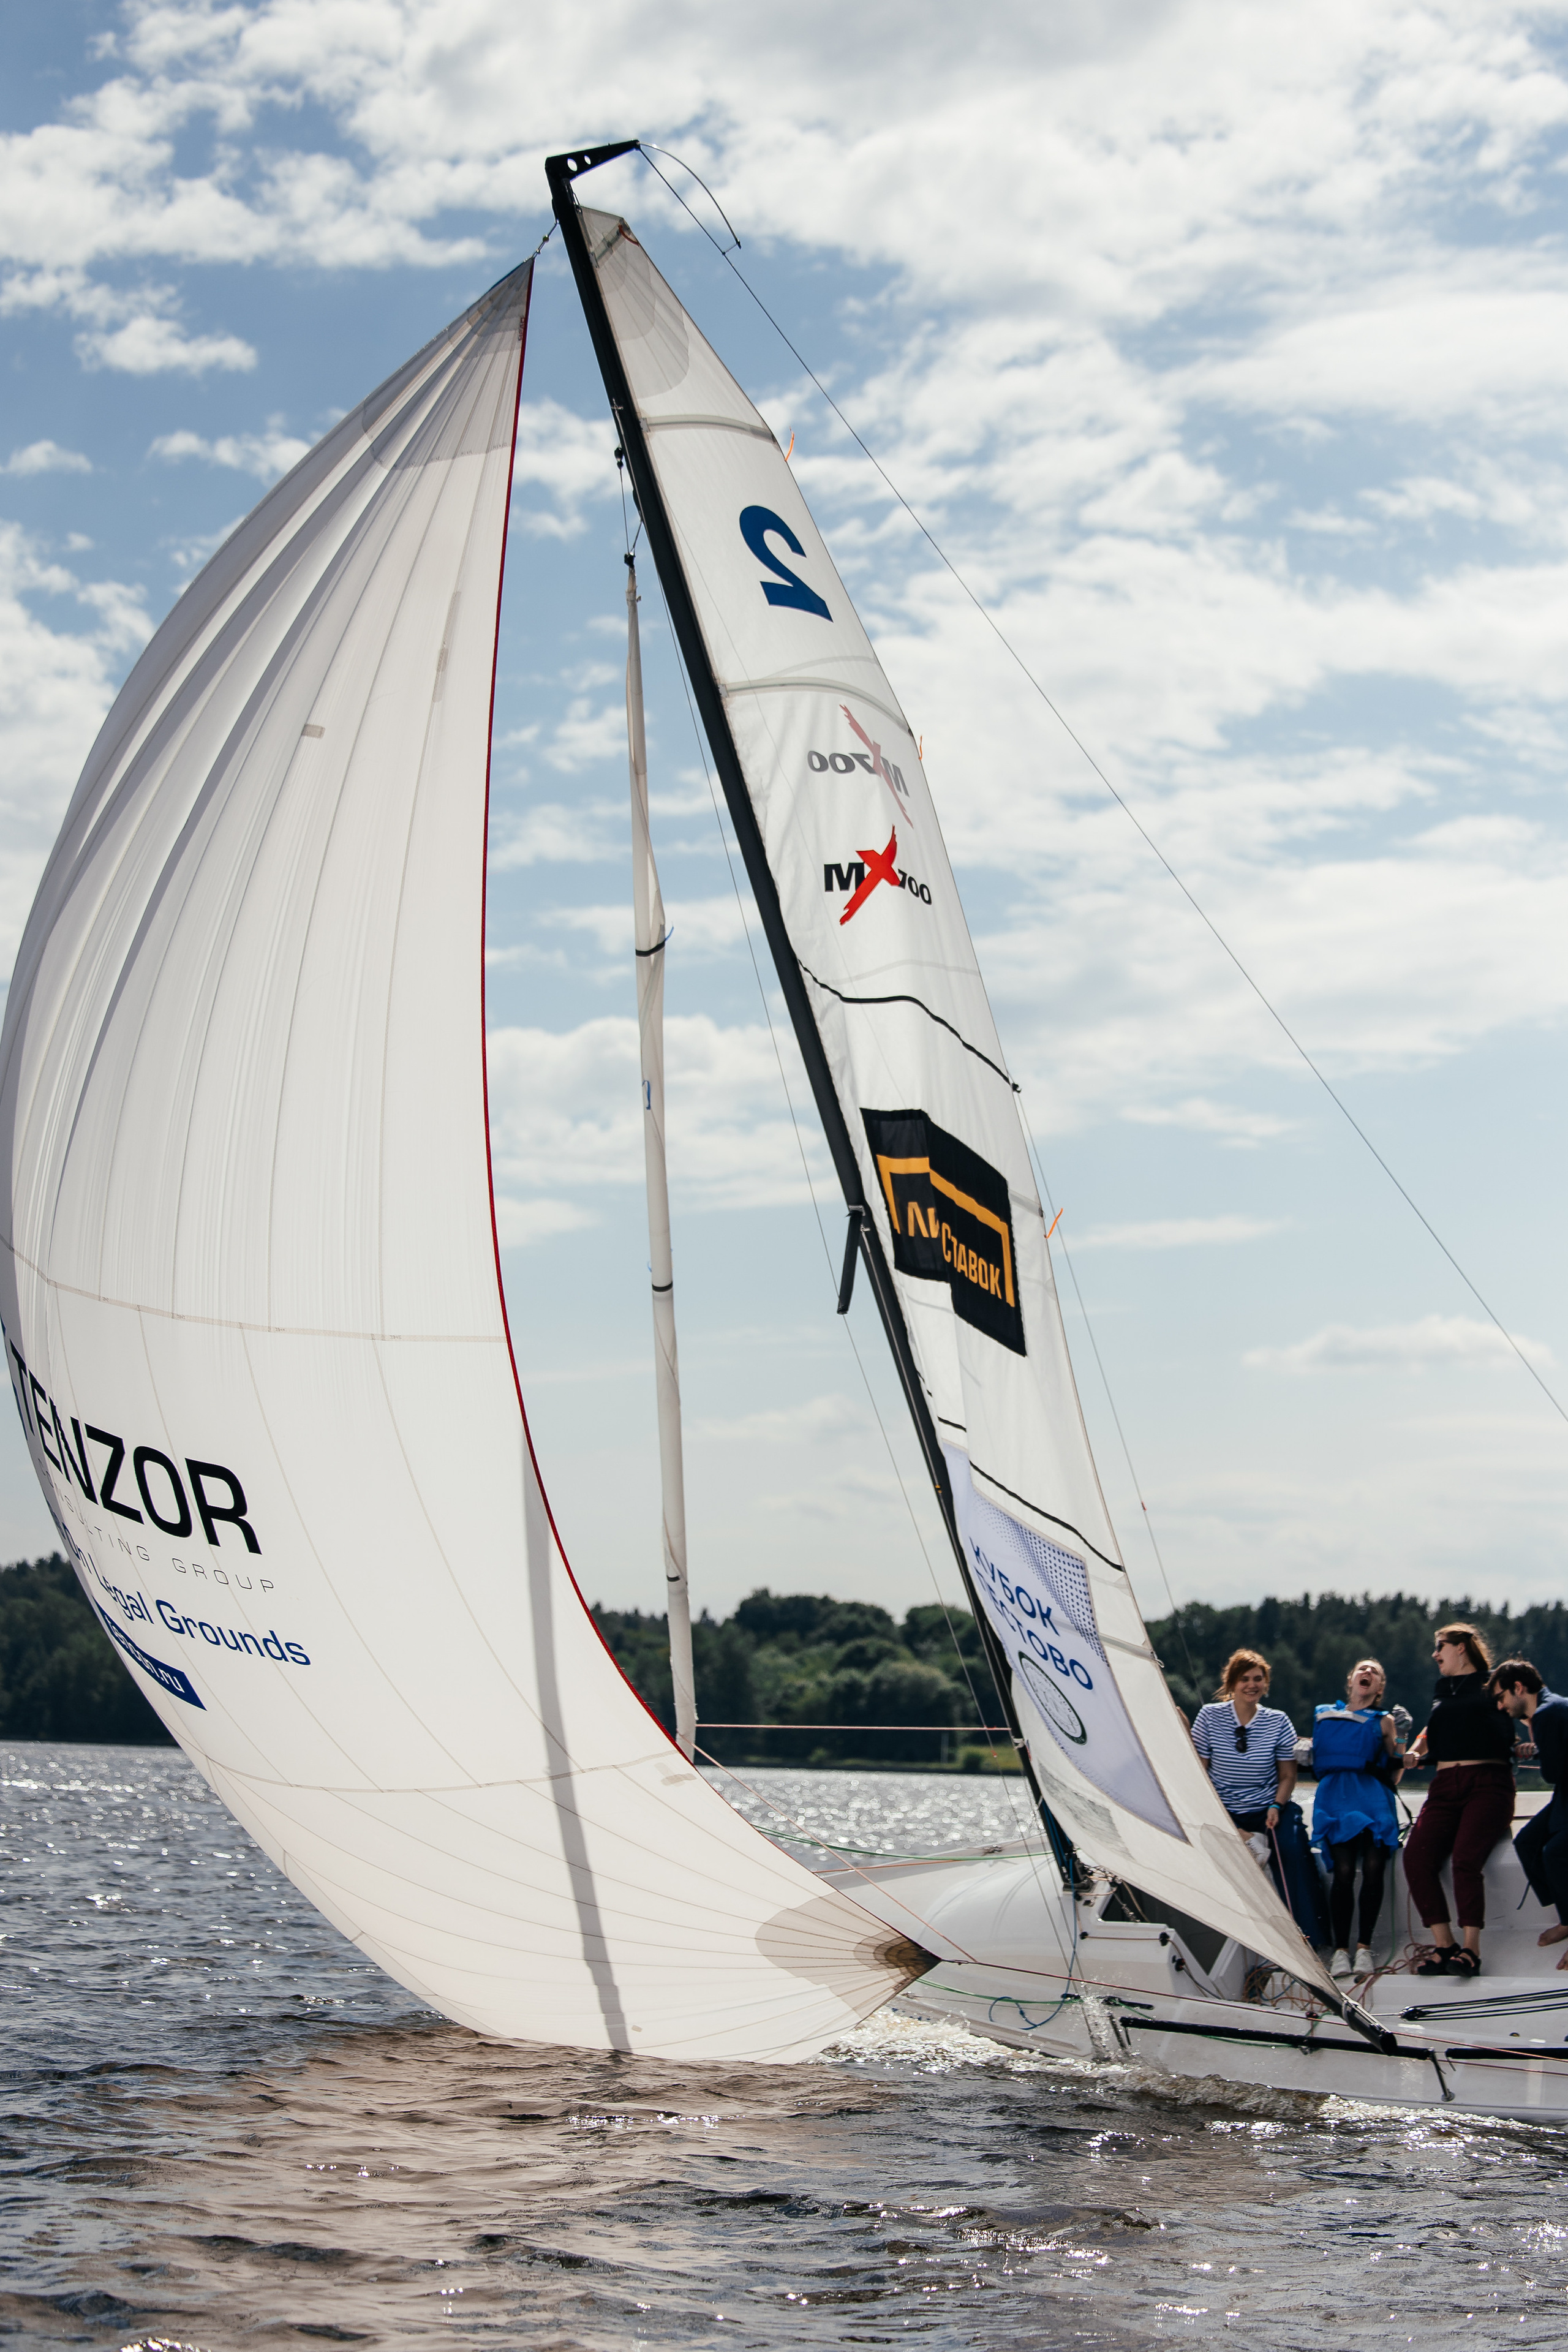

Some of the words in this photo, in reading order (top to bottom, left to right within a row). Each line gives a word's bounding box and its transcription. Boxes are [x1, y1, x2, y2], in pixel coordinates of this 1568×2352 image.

[823, 823, 932, 926] MX700
[941, 1222, 1002, 1300] СТАВОК
[9, 1338, 262, 1555] TENZOR
[87, 1551, 155, 1624] Legal
[156, 1599, 311, 1666] Grounds
[172, 1558, 274, 1593] GROUP
[969, 1536, 1060, 1637] КУБОК
